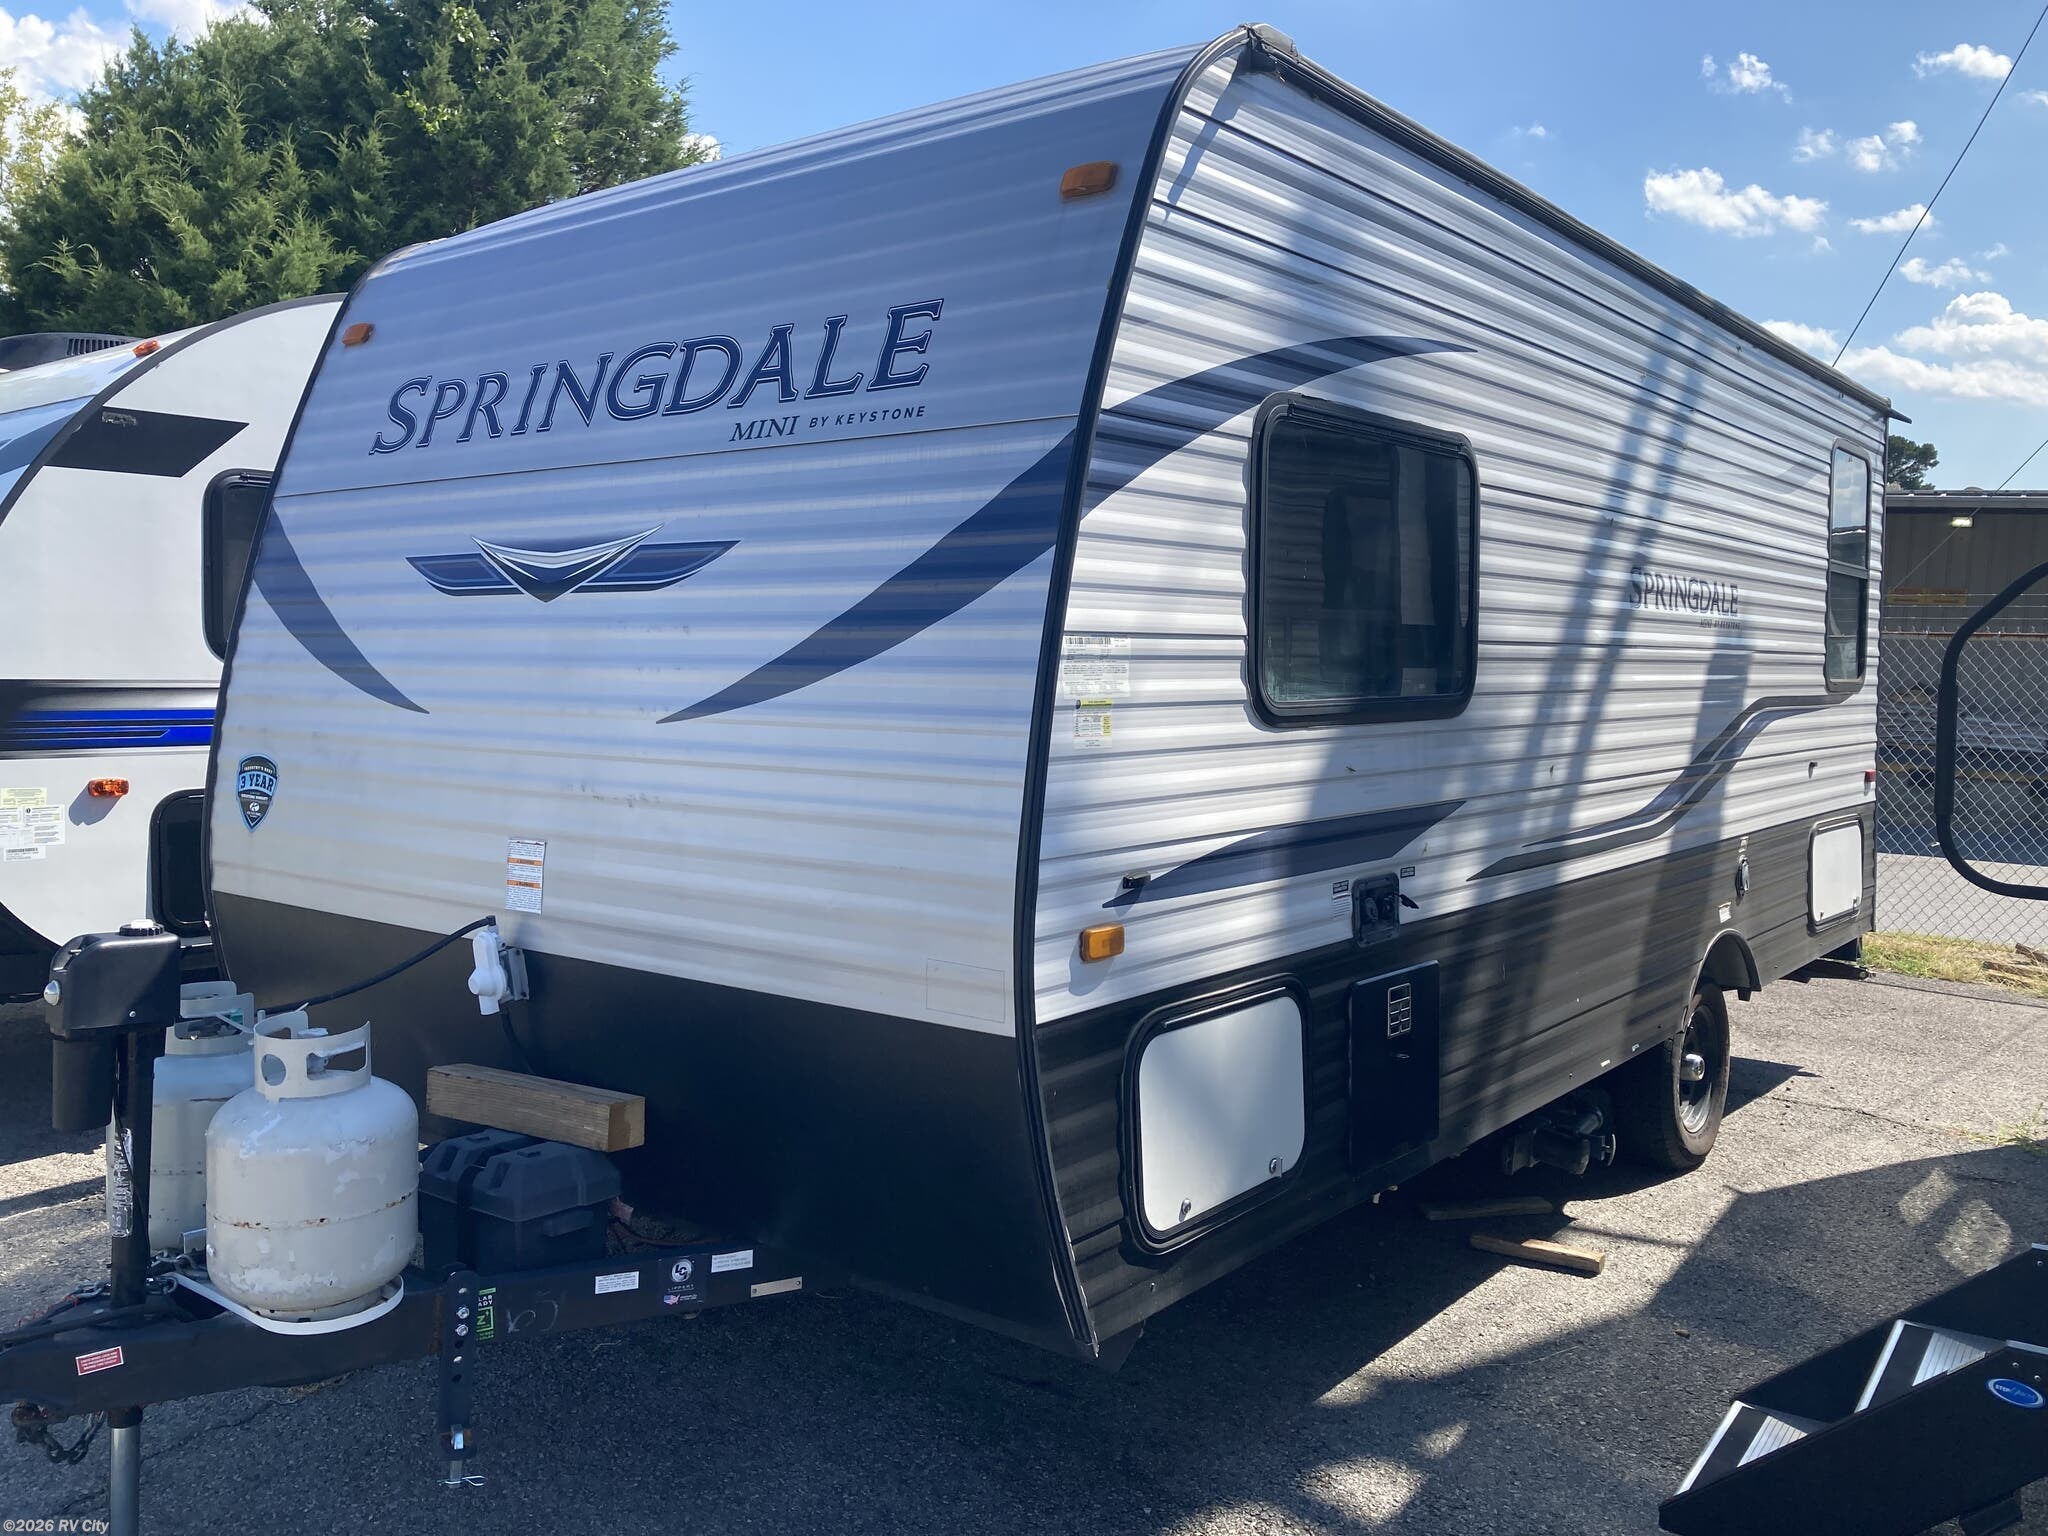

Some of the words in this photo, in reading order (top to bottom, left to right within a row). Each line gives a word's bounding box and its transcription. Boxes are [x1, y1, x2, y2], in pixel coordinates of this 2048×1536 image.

[369, 298, 944, 455] SPRINGDALE
[729, 415, 800, 442] MINI
[809, 417, 830, 428] BY
[835, 406, 925, 426] KEYSTONE
[1629, 566, 1738, 617] SPRINGDALE
[240, 776, 246, 789] 3
[249, 773, 274, 793] YEAR
